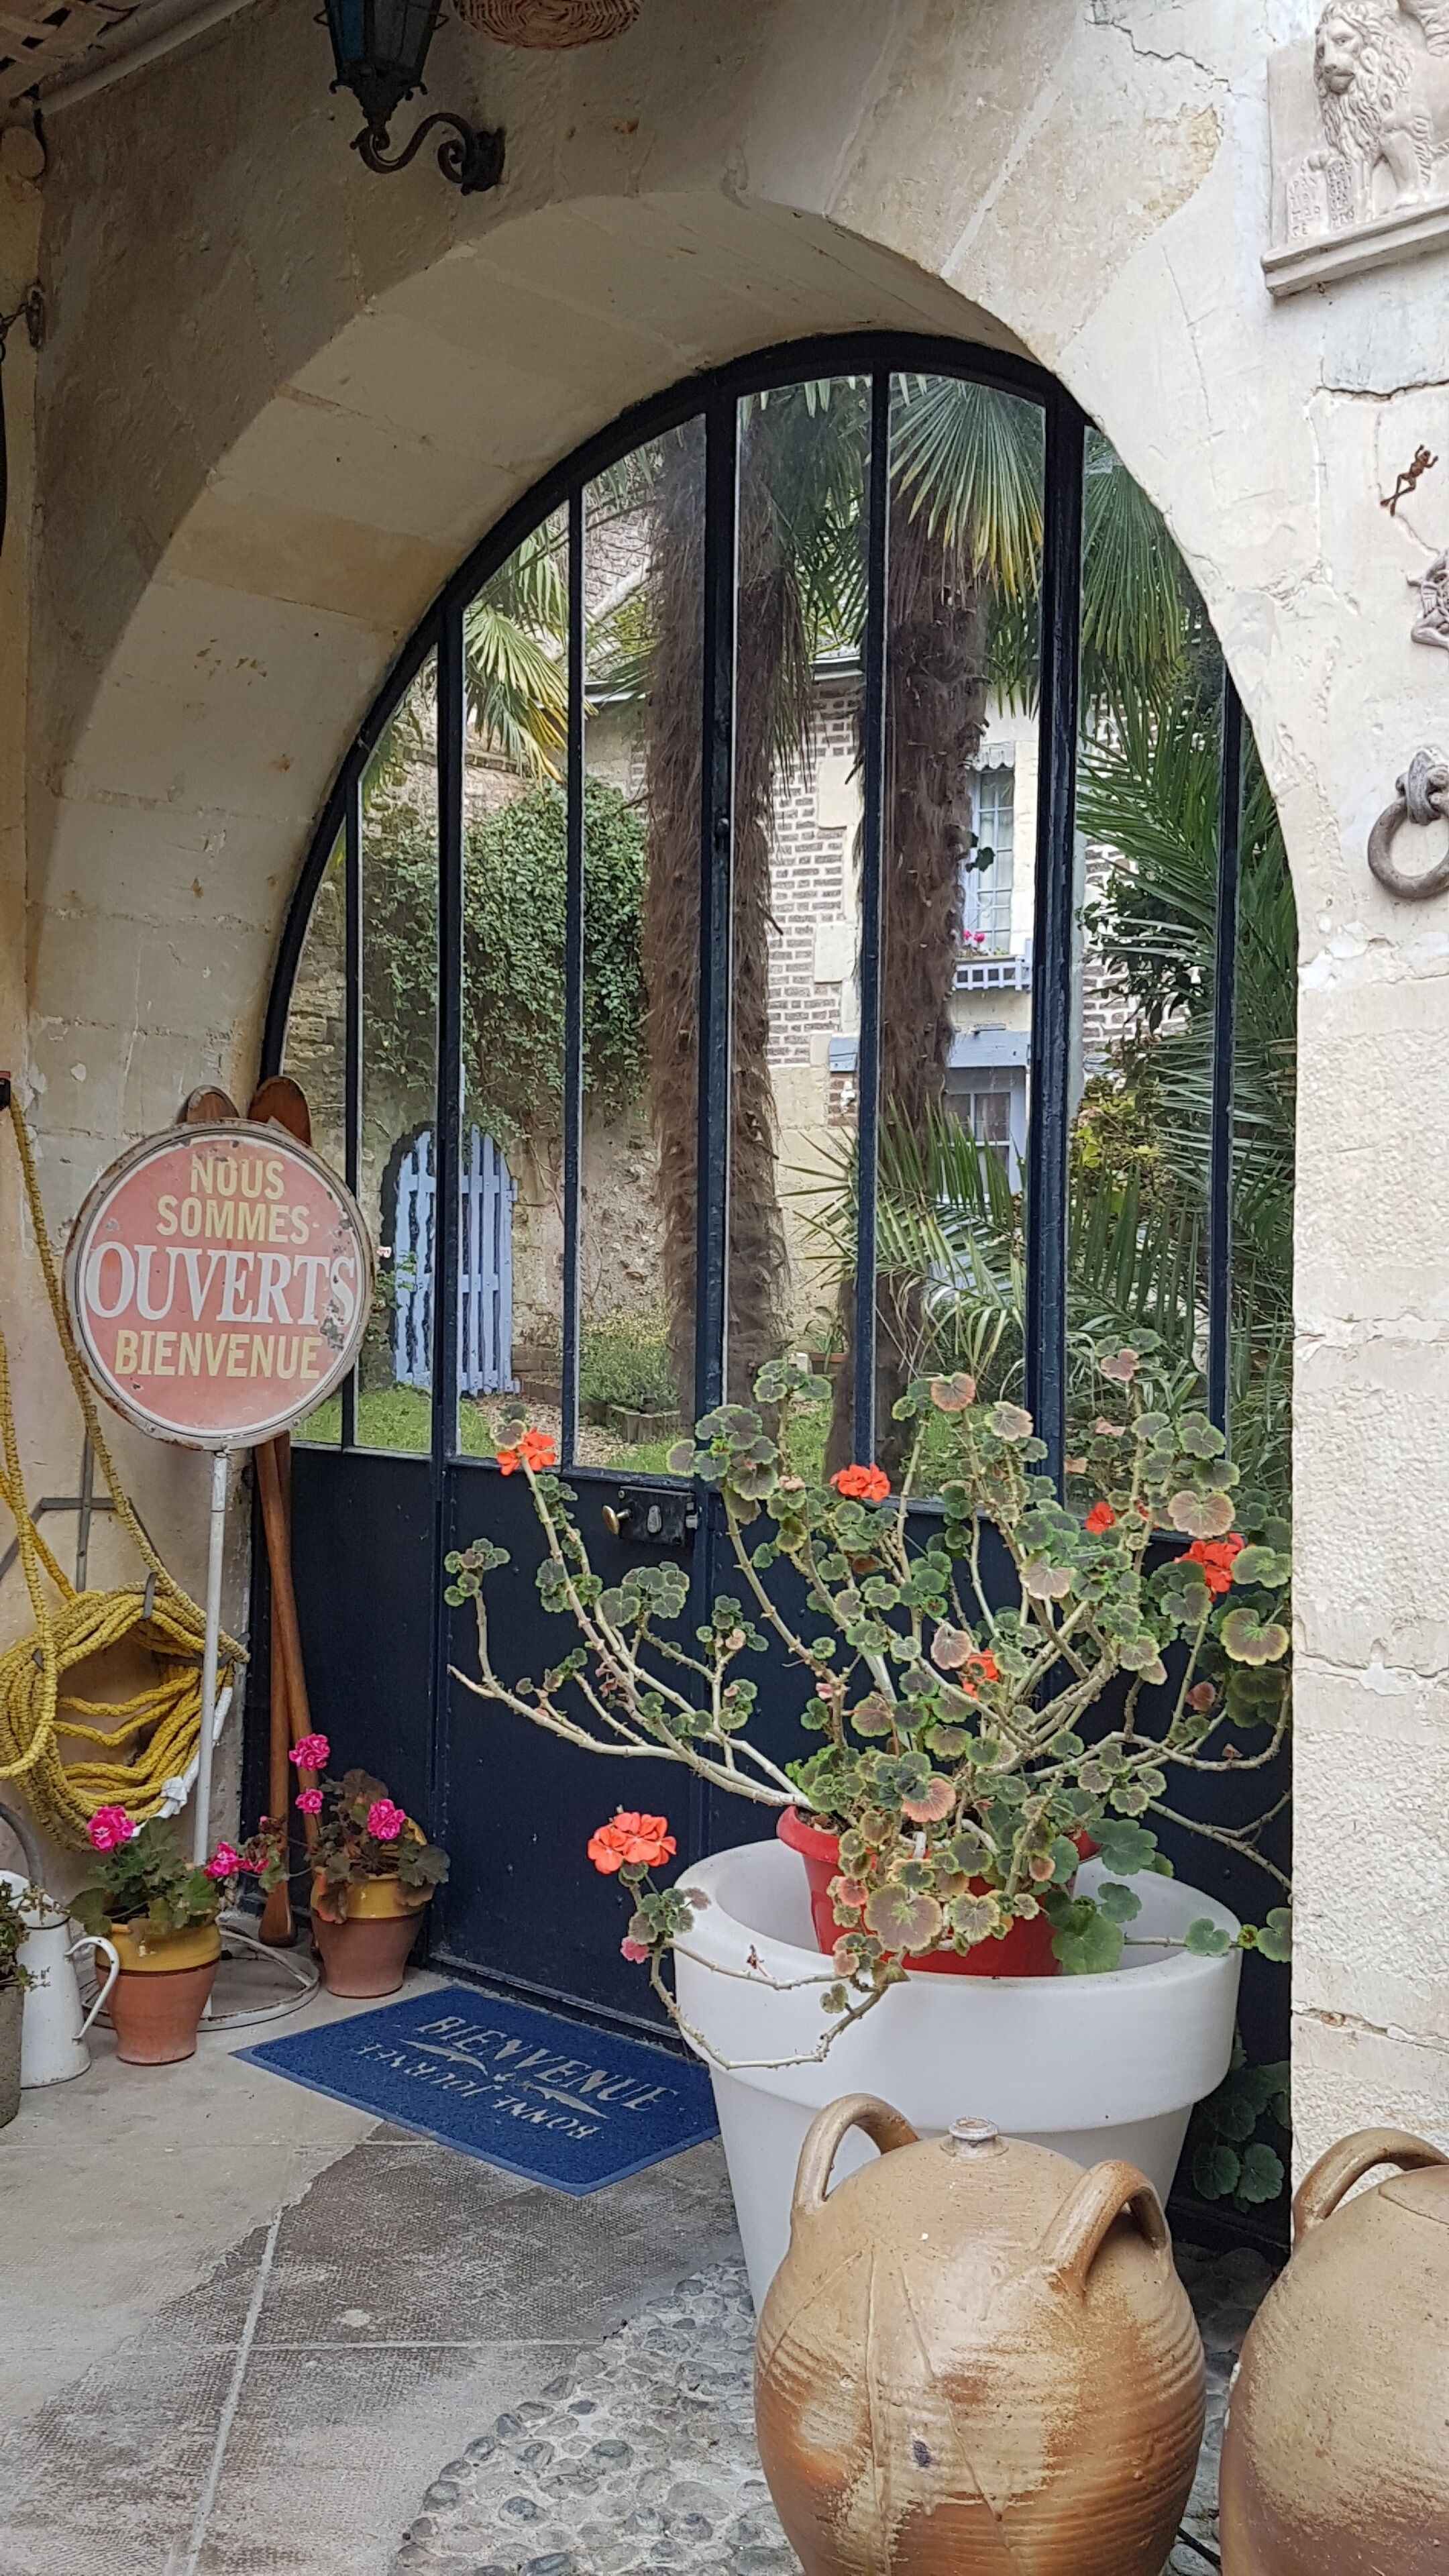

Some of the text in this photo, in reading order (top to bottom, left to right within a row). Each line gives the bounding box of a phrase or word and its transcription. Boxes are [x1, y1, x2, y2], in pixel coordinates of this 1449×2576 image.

[191, 1155, 285, 1200] NOUS
[156, 1195, 310, 1244] SOMMES
[85, 1241, 355, 1326] OUVERTS
[115, 1329, 323, 1380] BIENVENUE
[414, 2016, 679, 2111] BIENVENUE
[492, 2094, 602, 2139] BONNE
